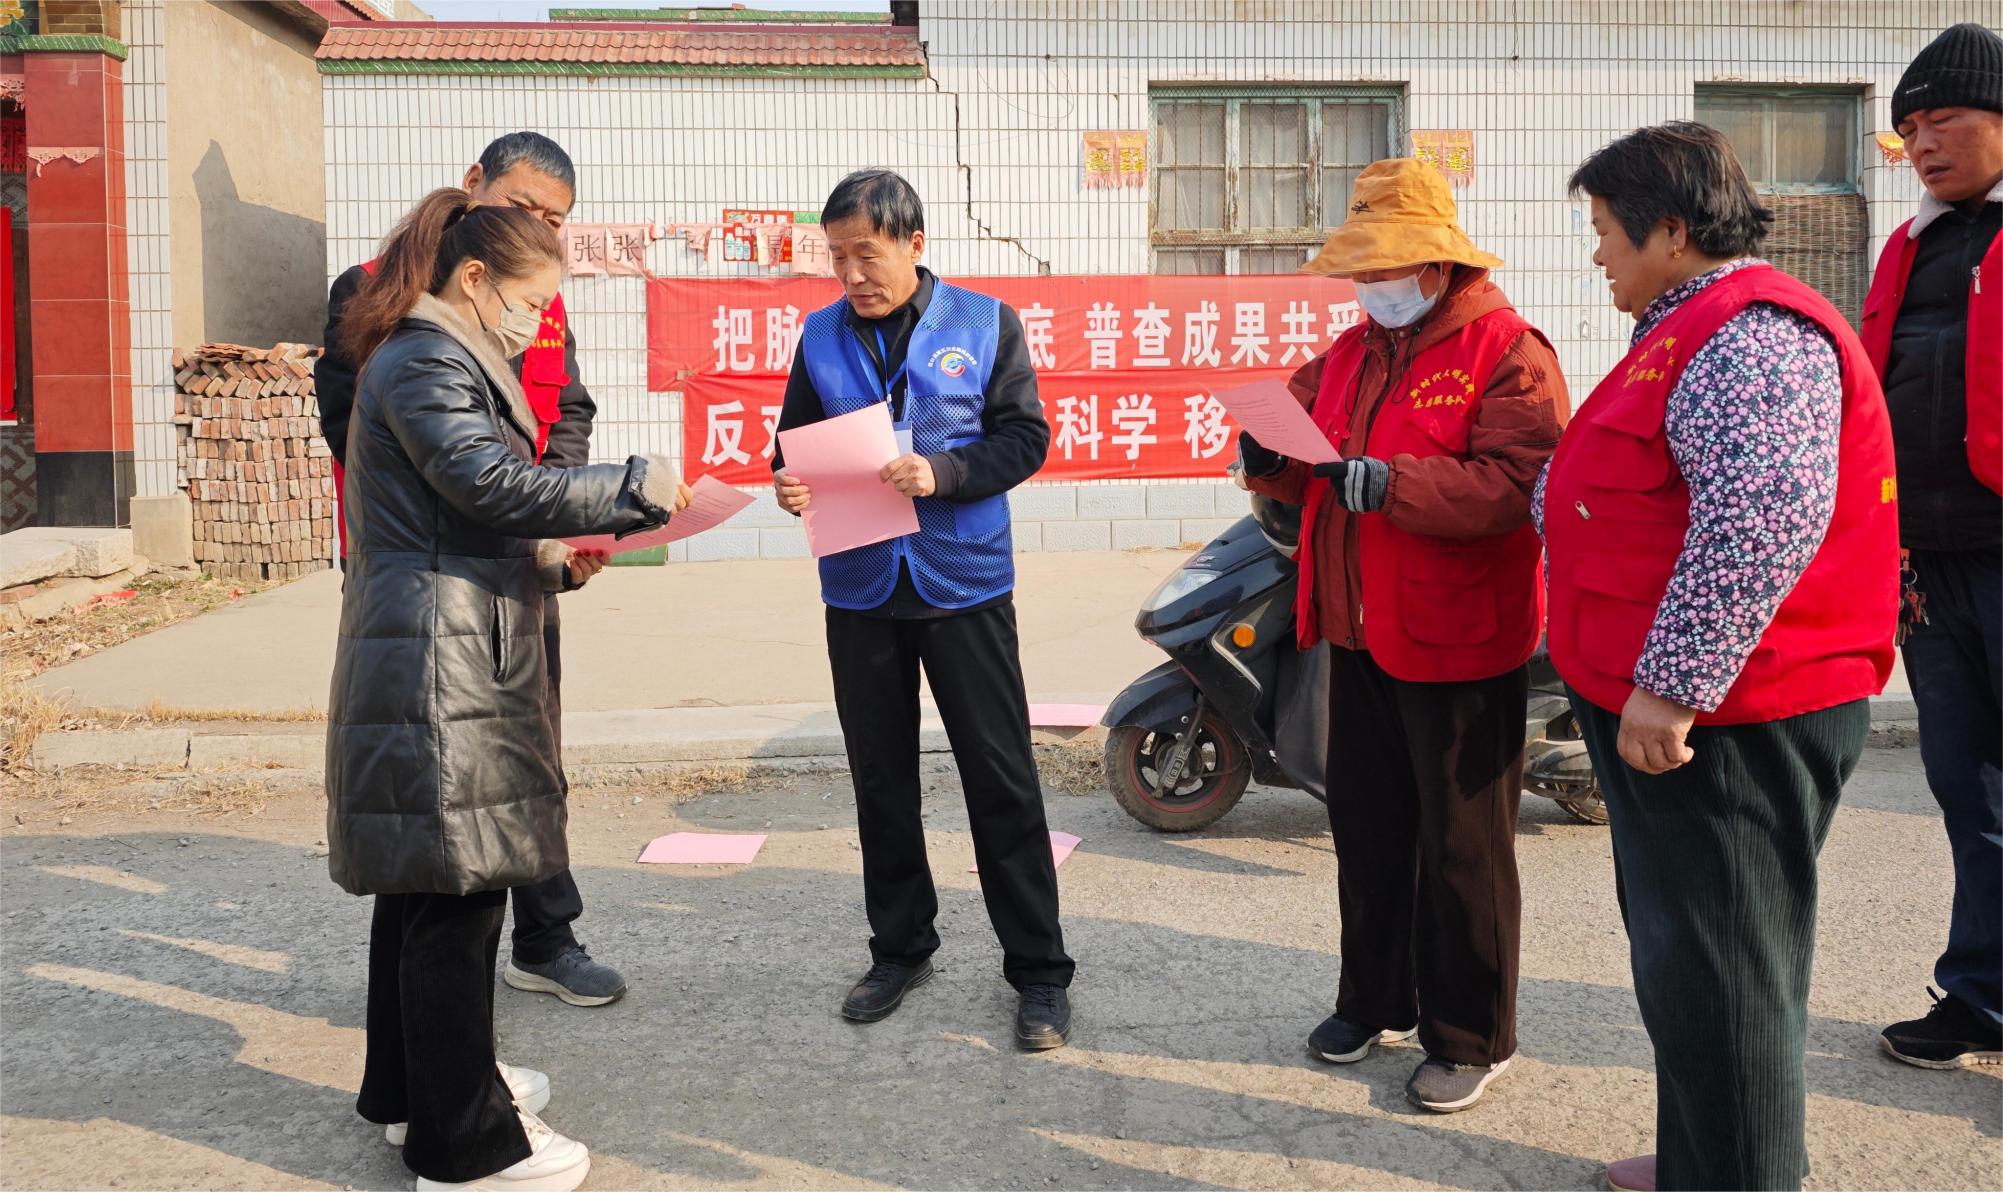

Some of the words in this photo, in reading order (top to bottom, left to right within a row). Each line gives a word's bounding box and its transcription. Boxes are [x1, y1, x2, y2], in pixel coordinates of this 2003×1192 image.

[712, 303, 804, 374] 把脉
[1018, 301, 1057, 370] 底
[1039, 393, 1158, 461] 科学
[1183, 393, 1231, 460] 移
